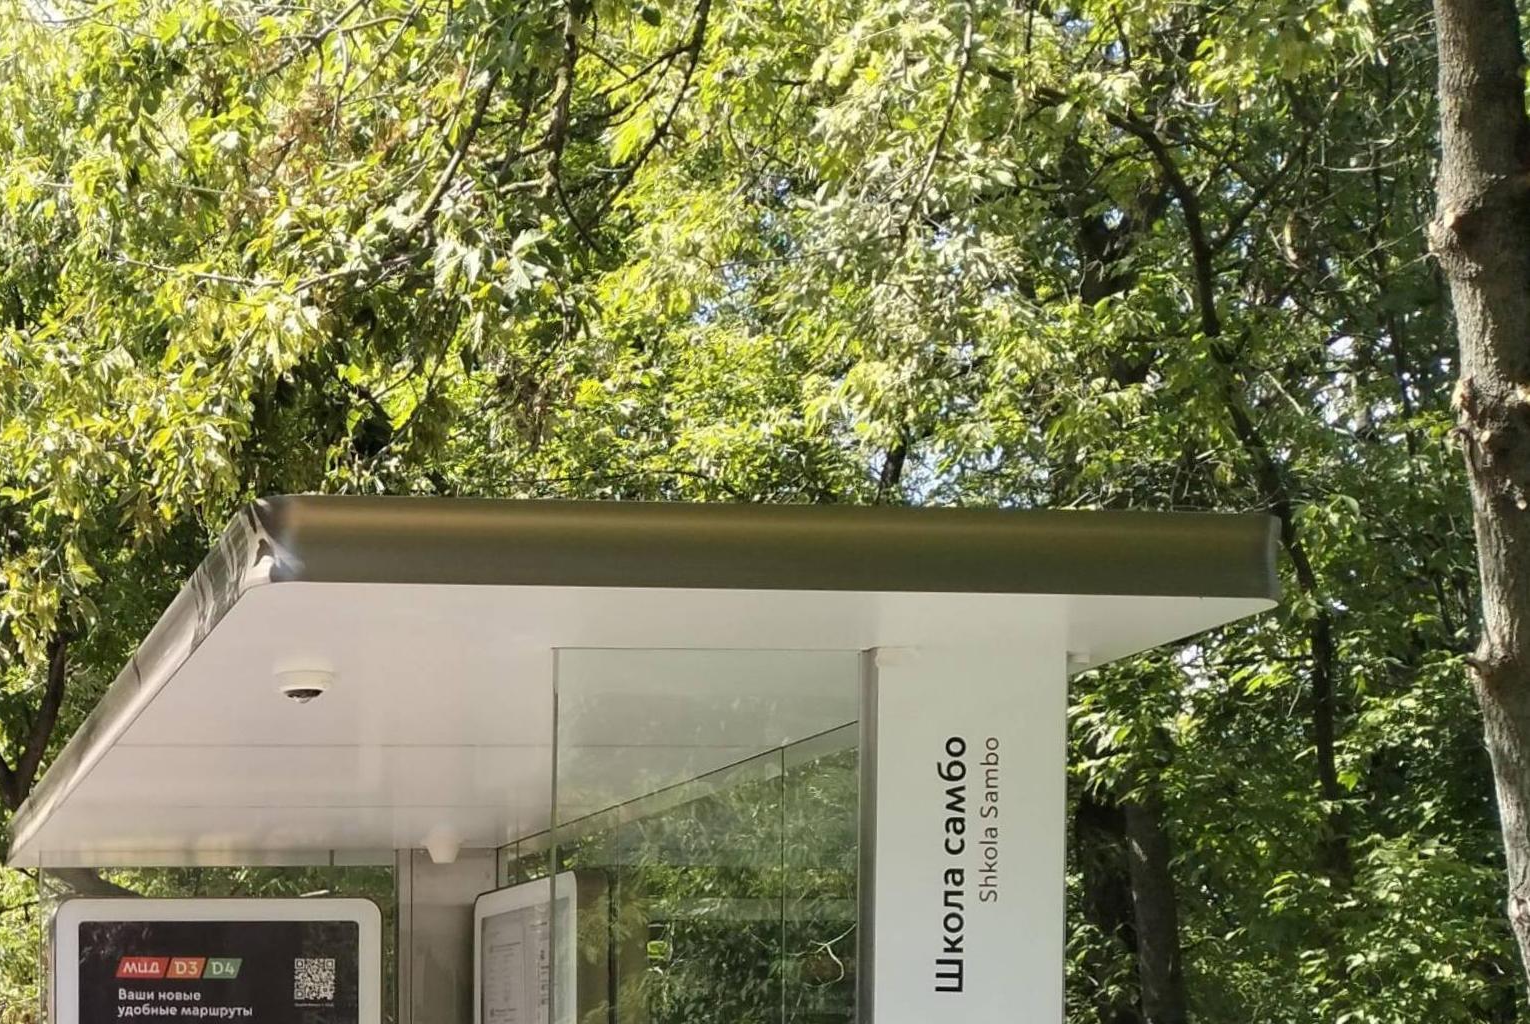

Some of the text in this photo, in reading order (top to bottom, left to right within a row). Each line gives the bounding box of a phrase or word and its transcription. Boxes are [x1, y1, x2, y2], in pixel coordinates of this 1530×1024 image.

[979, 736, 999, 902] Shkola Sambo
[935, 736, 967, 992] Школа самбо
[122, 961, 235, 975] МЦД D3 D4
[118, 988, 201, 1001] Ваши новые
[117, 1003, 253, 1019] удобные маршруты
